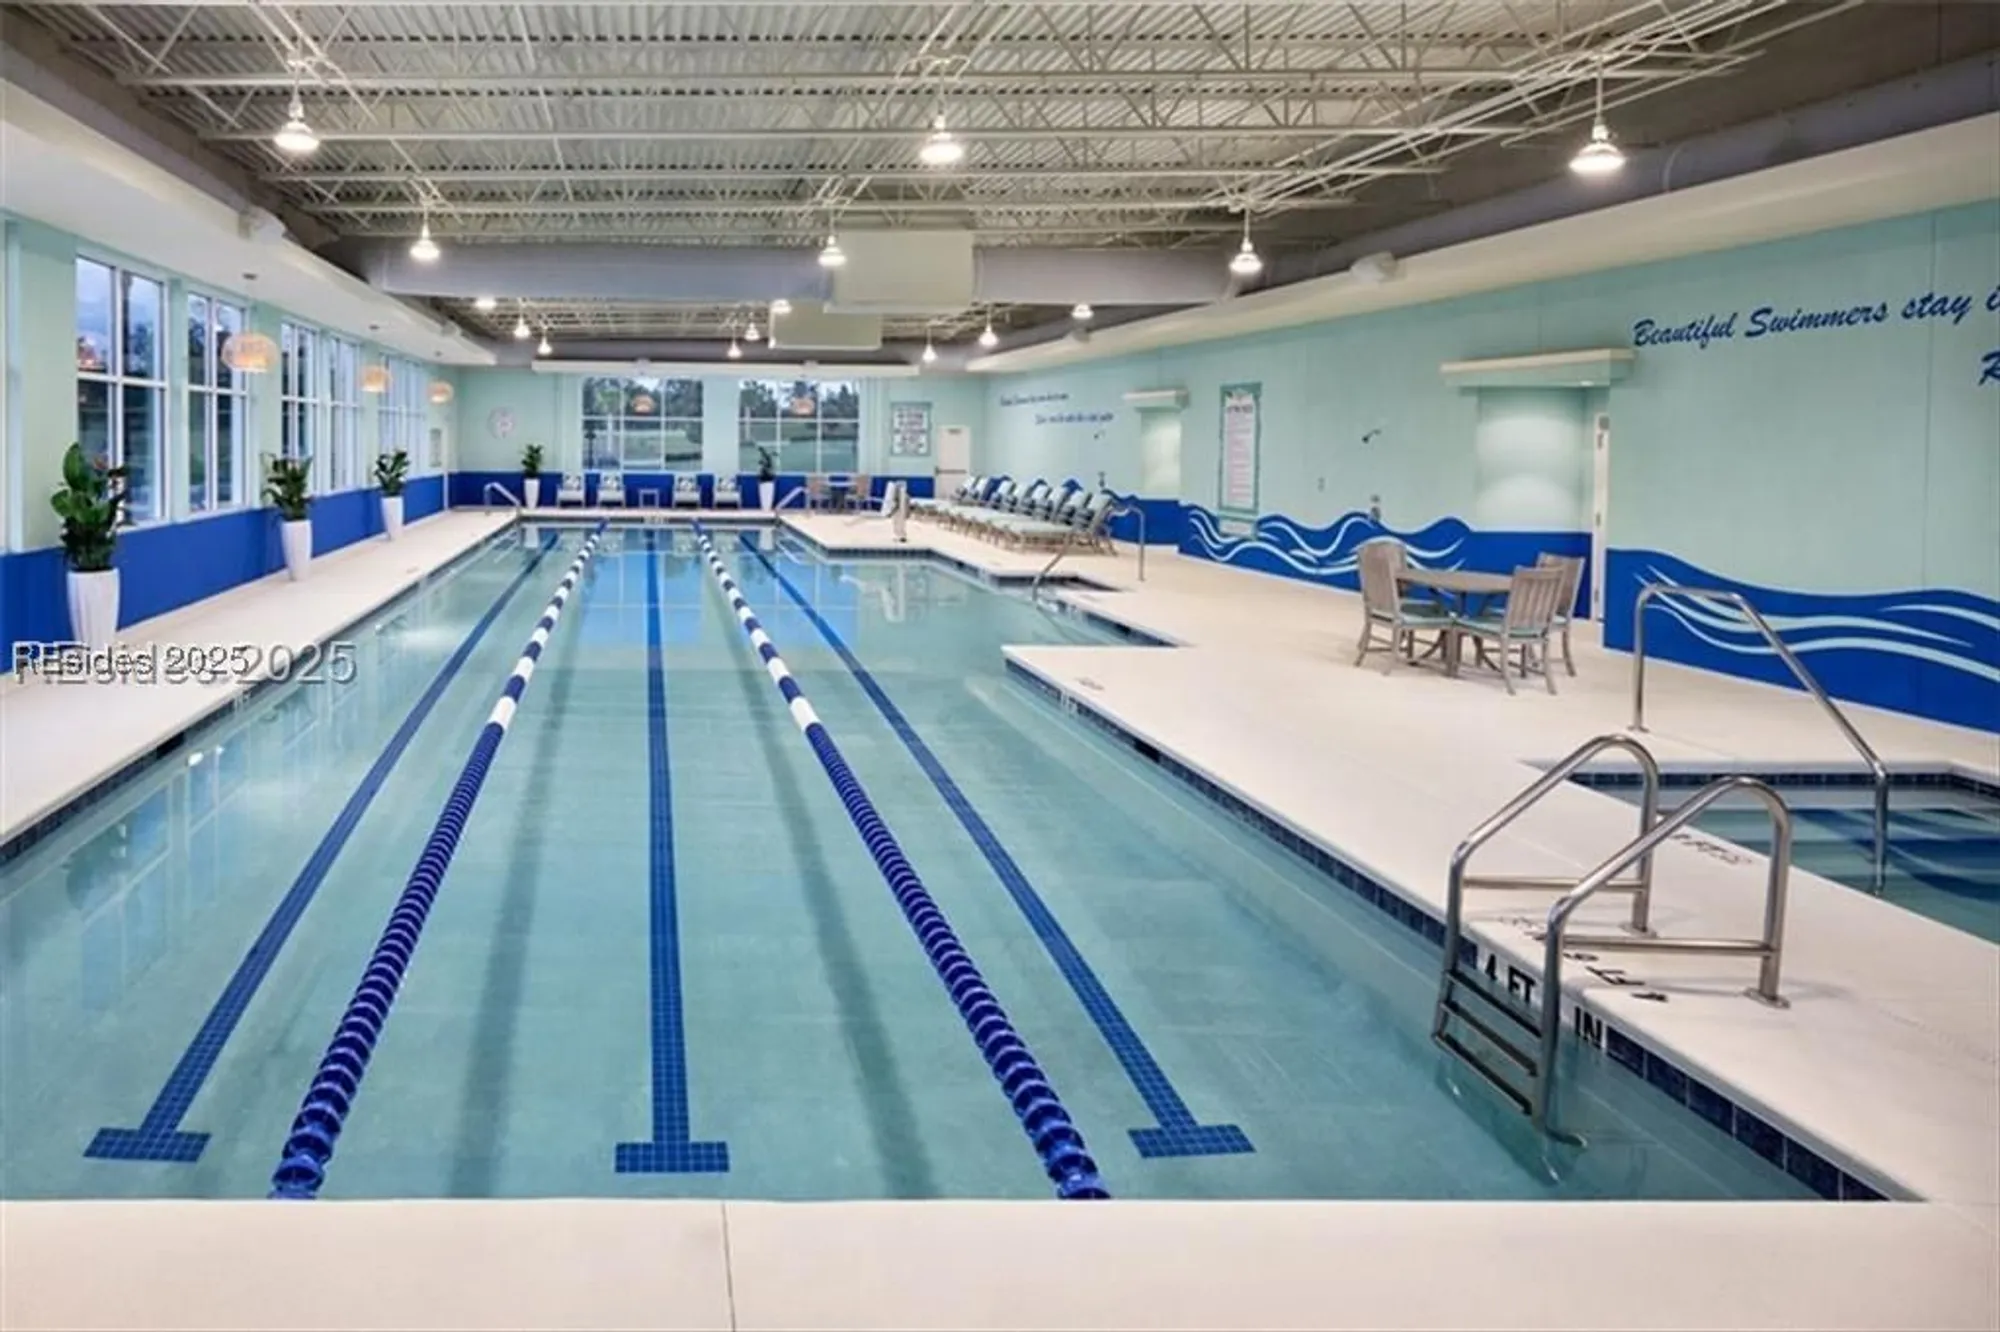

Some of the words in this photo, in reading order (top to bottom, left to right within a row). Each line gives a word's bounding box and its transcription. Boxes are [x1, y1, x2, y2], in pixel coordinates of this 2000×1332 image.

[1633, 313, 1738, 349] Beautiful
[1744, 302, 1888, 338] Swimmers
[1901, 291, 1972, 325] stay
[1508, 965, 1537, 1004] FT
[1574, 1005, 1602, 1049] IN
